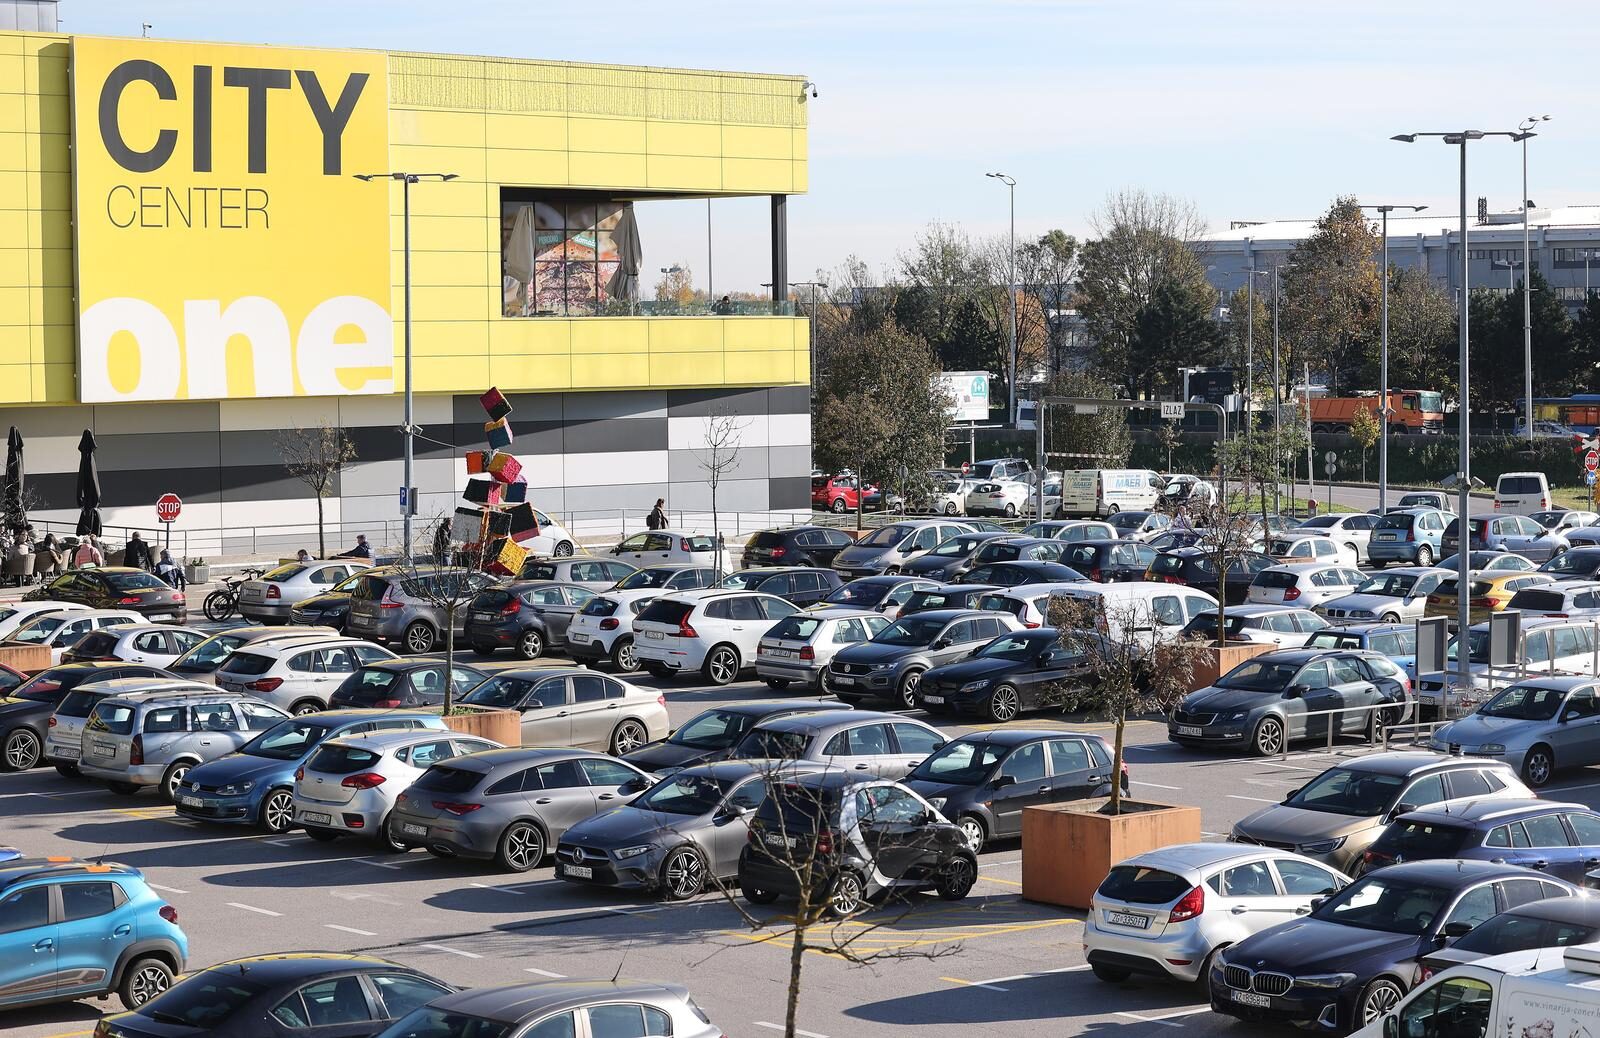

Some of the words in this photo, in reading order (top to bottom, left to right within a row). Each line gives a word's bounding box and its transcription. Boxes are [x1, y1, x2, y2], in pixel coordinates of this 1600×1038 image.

[98, 59, 370, 176] CITY
[107, 185, 269, 229] CENTER
[80, 295, 394, 403] one
[1163, 404, 1182, 416] IZLAZ
[1586, 456, 1598, 465] STOP
[158, 502, 180, 514] STOP
